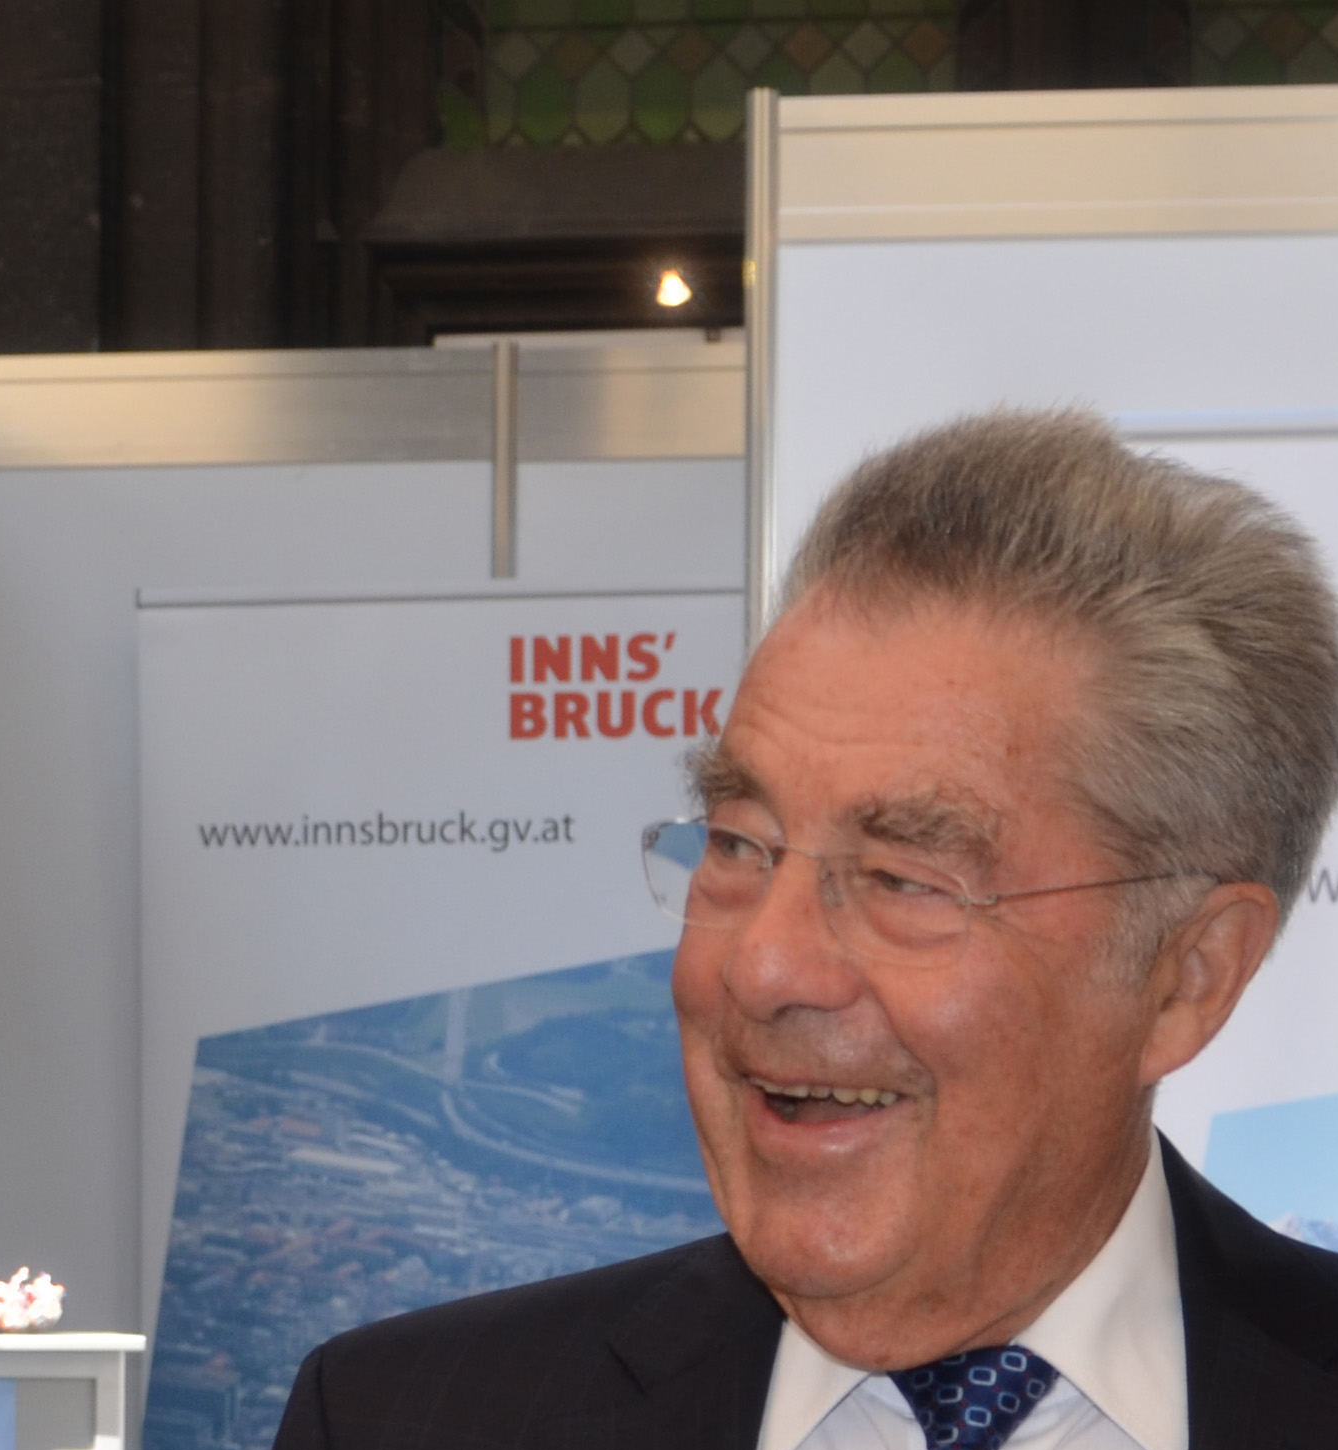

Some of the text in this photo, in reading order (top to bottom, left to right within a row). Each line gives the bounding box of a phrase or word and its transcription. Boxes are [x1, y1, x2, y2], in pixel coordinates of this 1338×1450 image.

[510, 632, 677, 684] INNS'
[509, 688, 722, 740] BRUCK
[198, 811, 576, 853] www.innsbruck.gv.at
